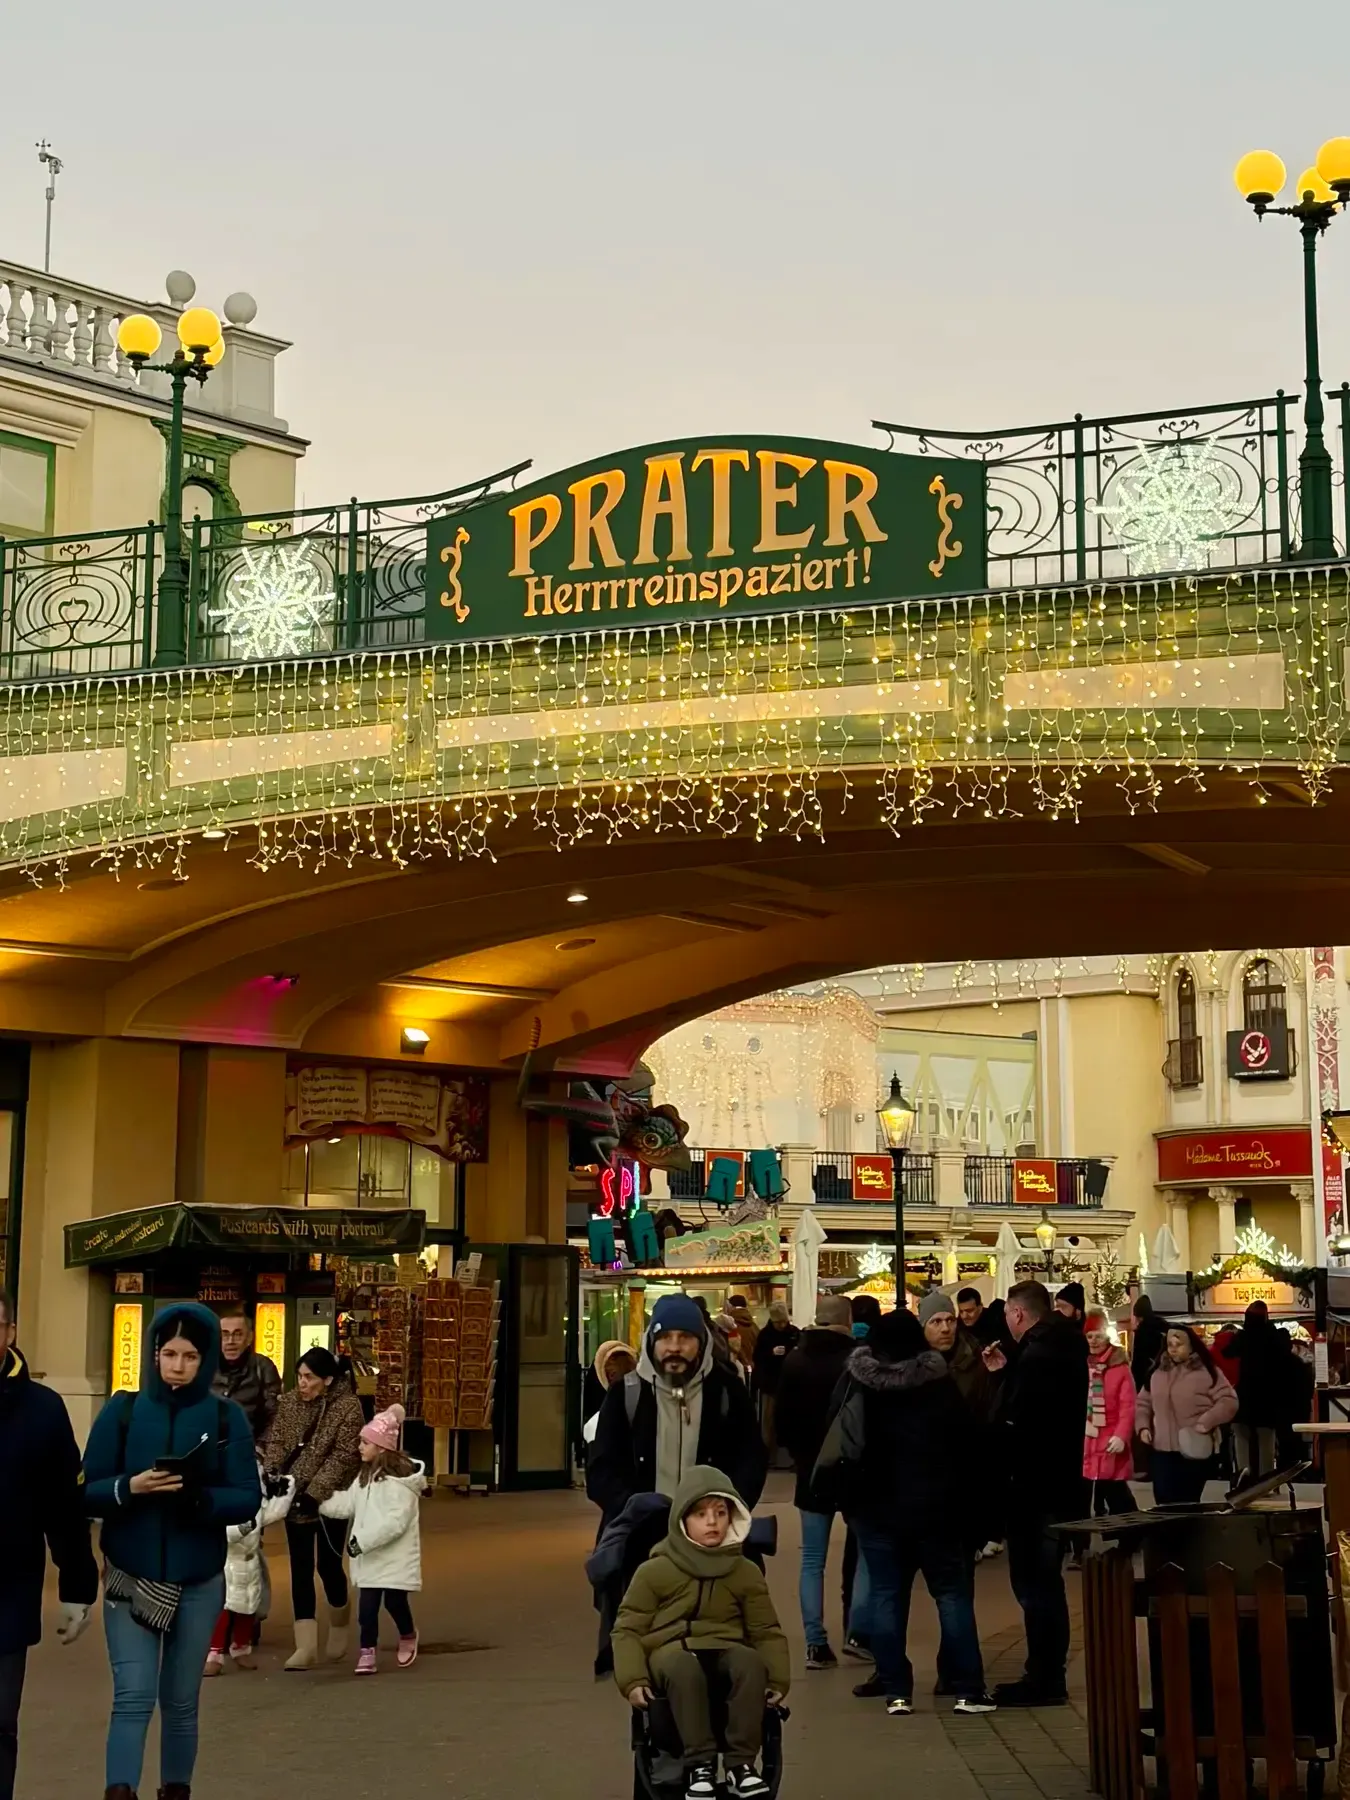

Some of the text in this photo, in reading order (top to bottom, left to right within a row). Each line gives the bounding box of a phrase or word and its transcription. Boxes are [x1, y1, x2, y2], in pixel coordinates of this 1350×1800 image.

[508, 449, 889, 577] PRATER
[523, 546, 872, 617] Herrrreinspaziert!
[1186, 1140, 1274, 1169] Madame Tussauds
[84, 1229, 109, 1252] Create
[131, 1213, 165, 1250] postcard
[219, 1215, 386, 1240] Postcards with your portrait
[119, 1321, 133, 1387] photo
